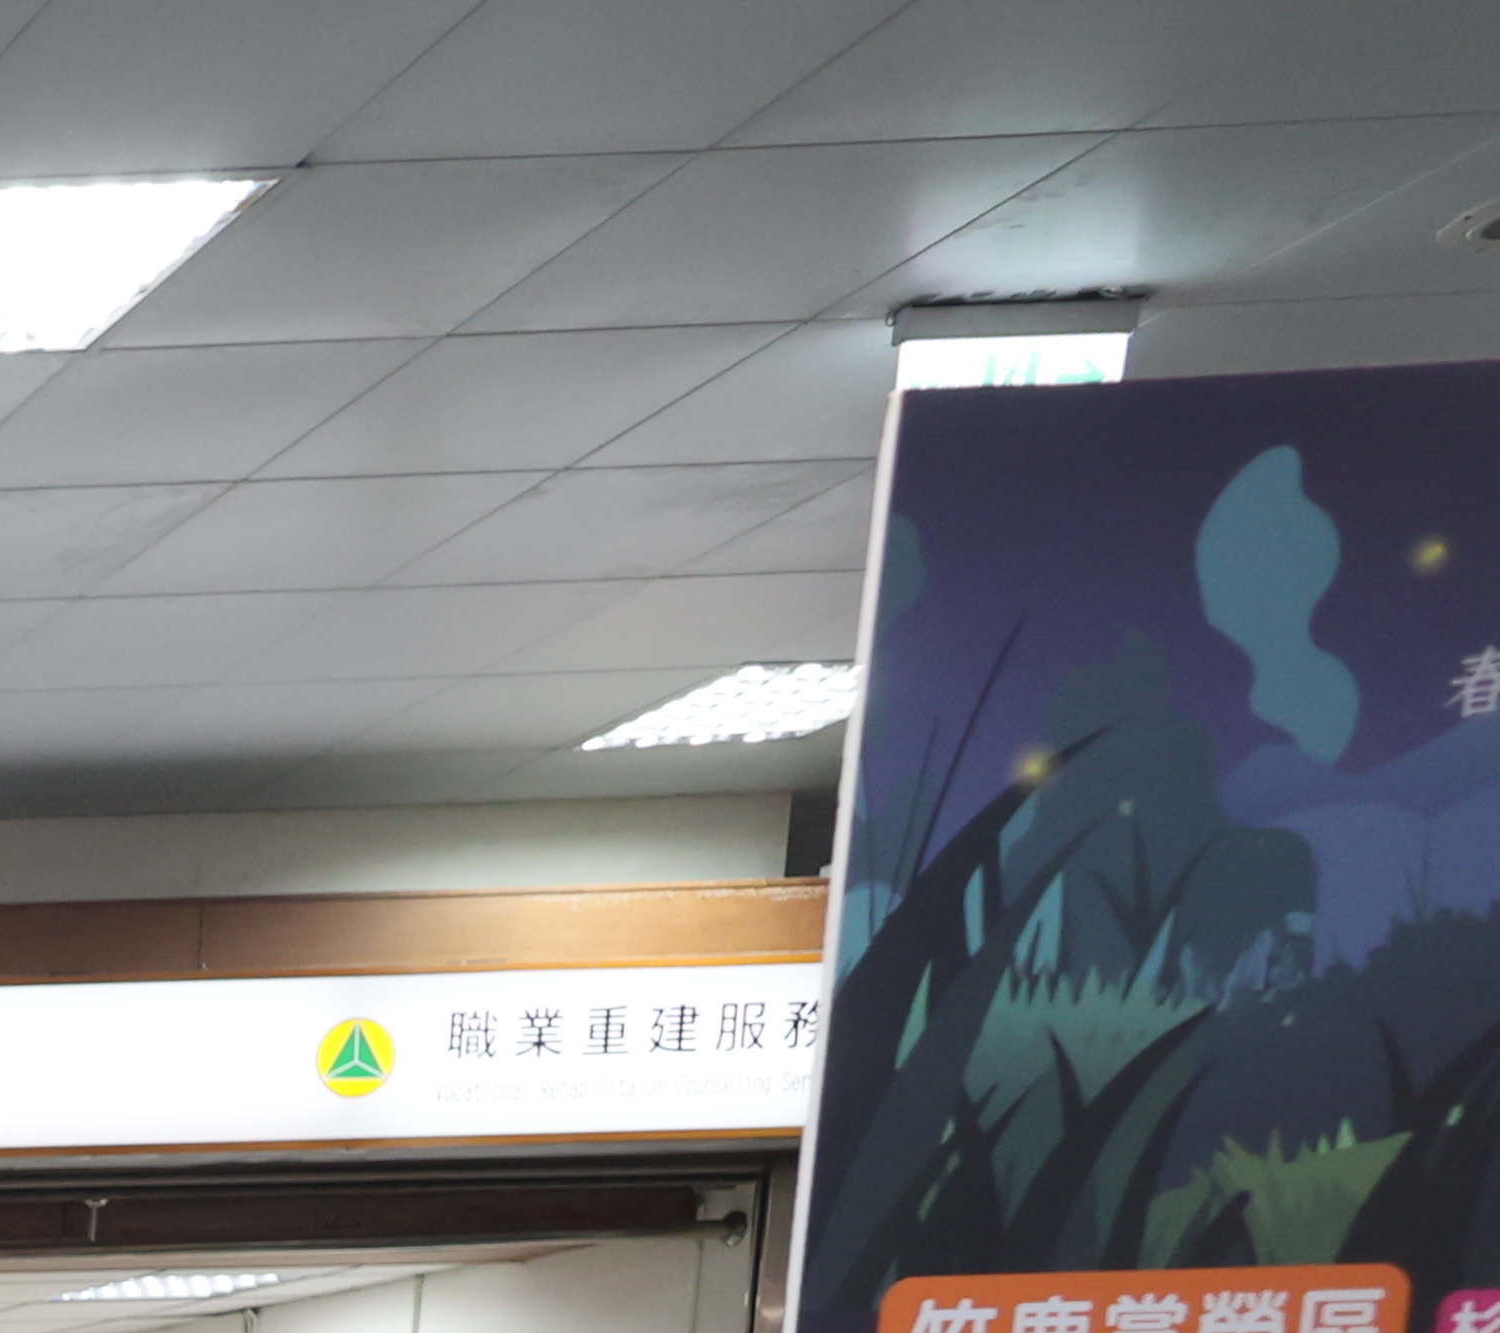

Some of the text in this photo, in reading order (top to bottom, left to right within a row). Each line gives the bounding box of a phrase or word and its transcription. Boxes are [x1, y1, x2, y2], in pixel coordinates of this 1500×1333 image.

[446, 1000, 820, 1059] 職業重建服務
